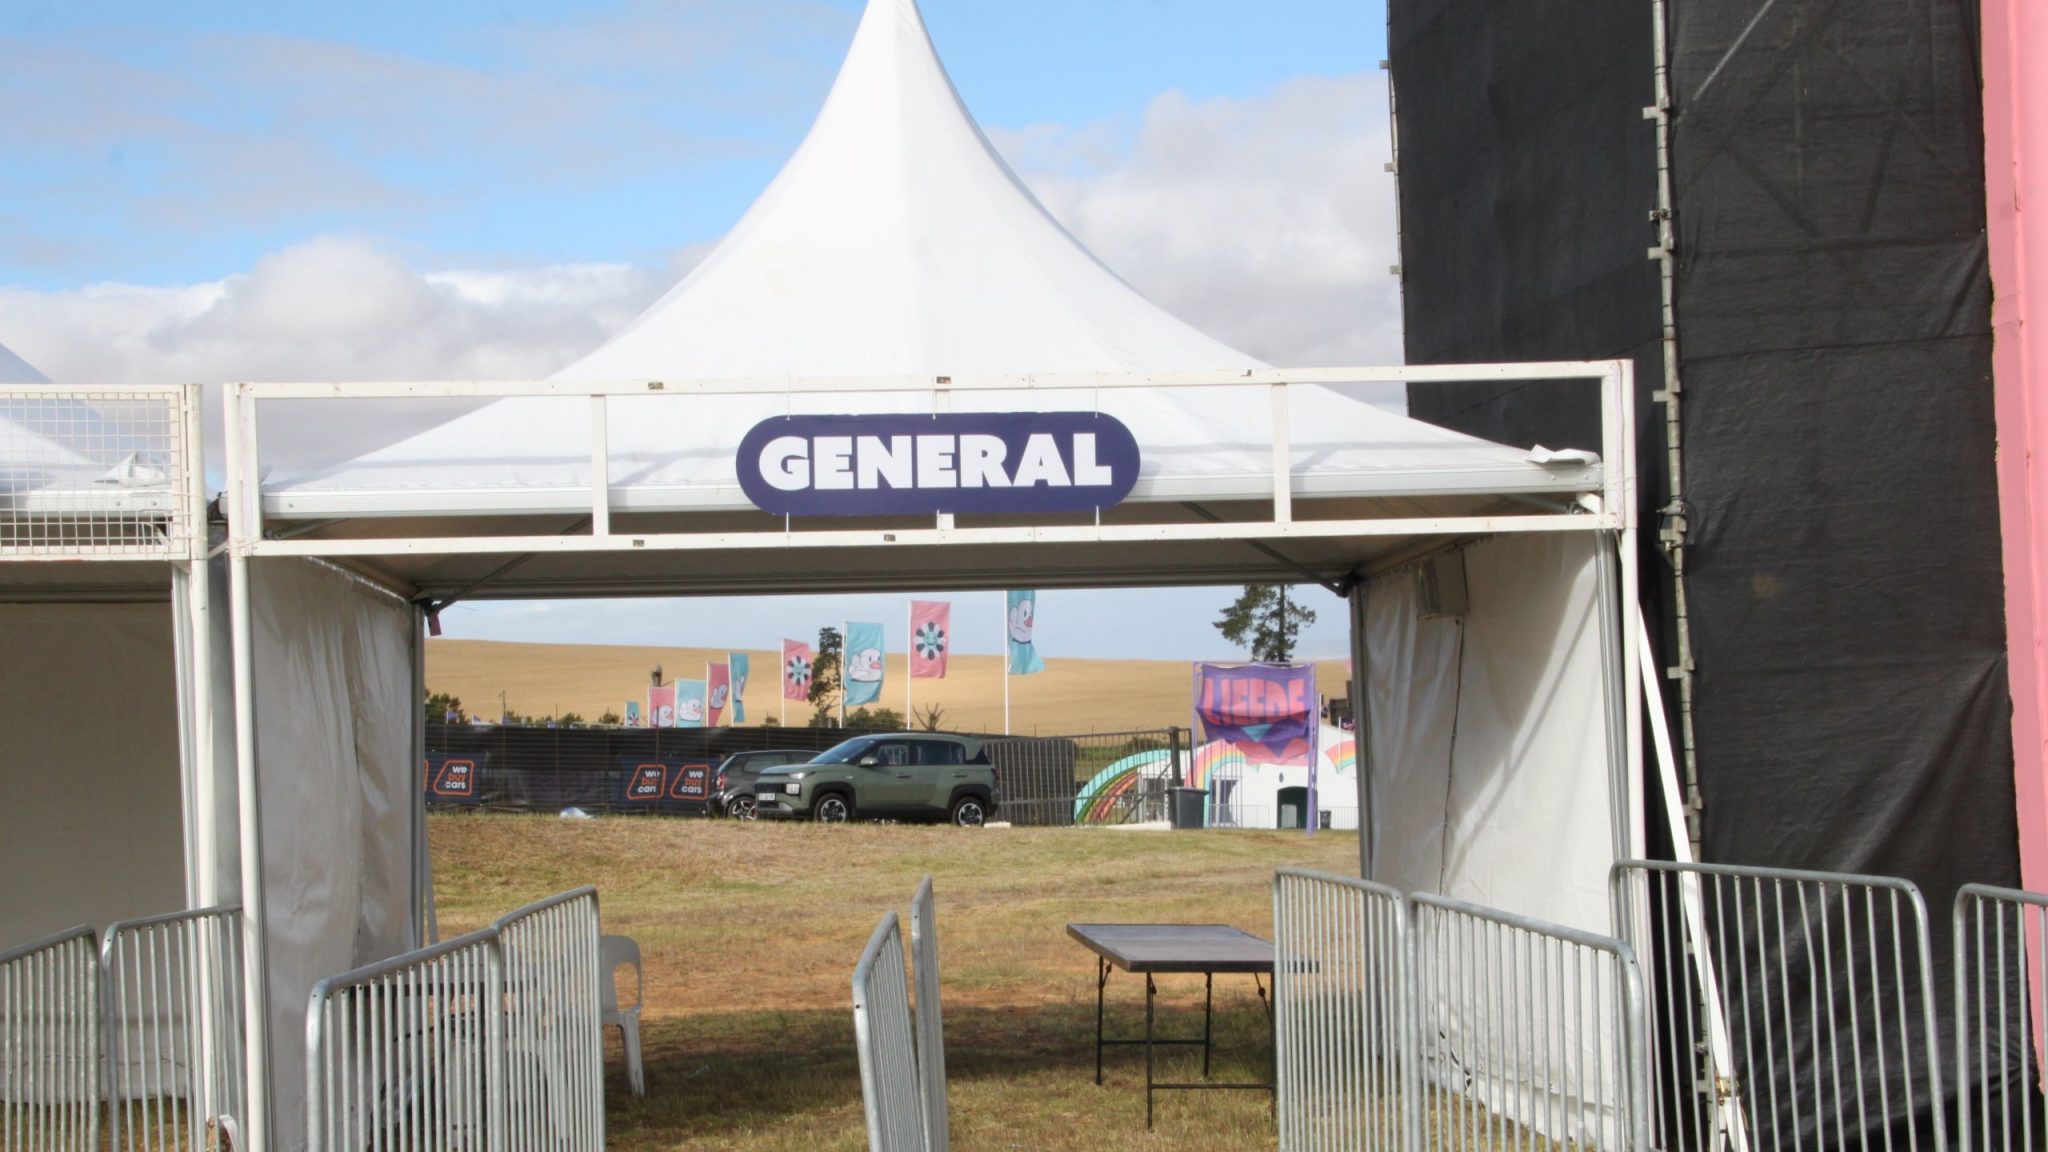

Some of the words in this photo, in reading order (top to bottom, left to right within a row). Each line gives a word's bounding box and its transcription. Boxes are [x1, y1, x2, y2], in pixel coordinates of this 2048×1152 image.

[758, 433, 1112, 490] GENERAL
[452, 766, 467, 774] we
[448, 773, 466, 781] buy
[446, 781, 466, 789] cars
[685, 778, 703, 786] buy
[638, 785, 657, 793] car
[681, 785, 702, 793] cars
